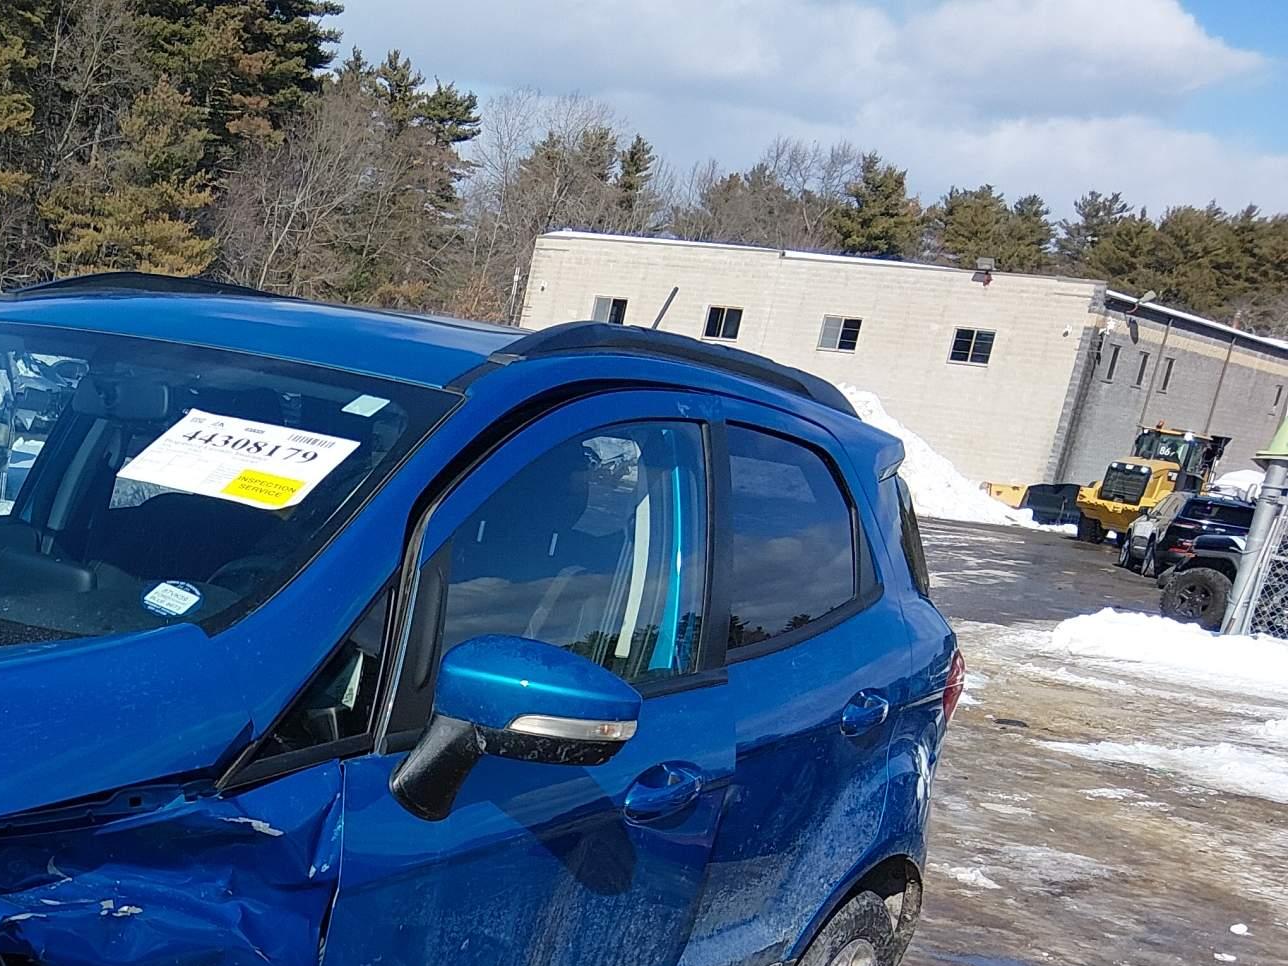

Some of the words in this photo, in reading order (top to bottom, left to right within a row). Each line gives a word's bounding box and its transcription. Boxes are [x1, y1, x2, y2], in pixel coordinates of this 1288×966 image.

[182, 429, 319, 464] 44308179
[238, 475, 297, 494] INSPECTION
[238, 483, 283, 498] SERVICE
